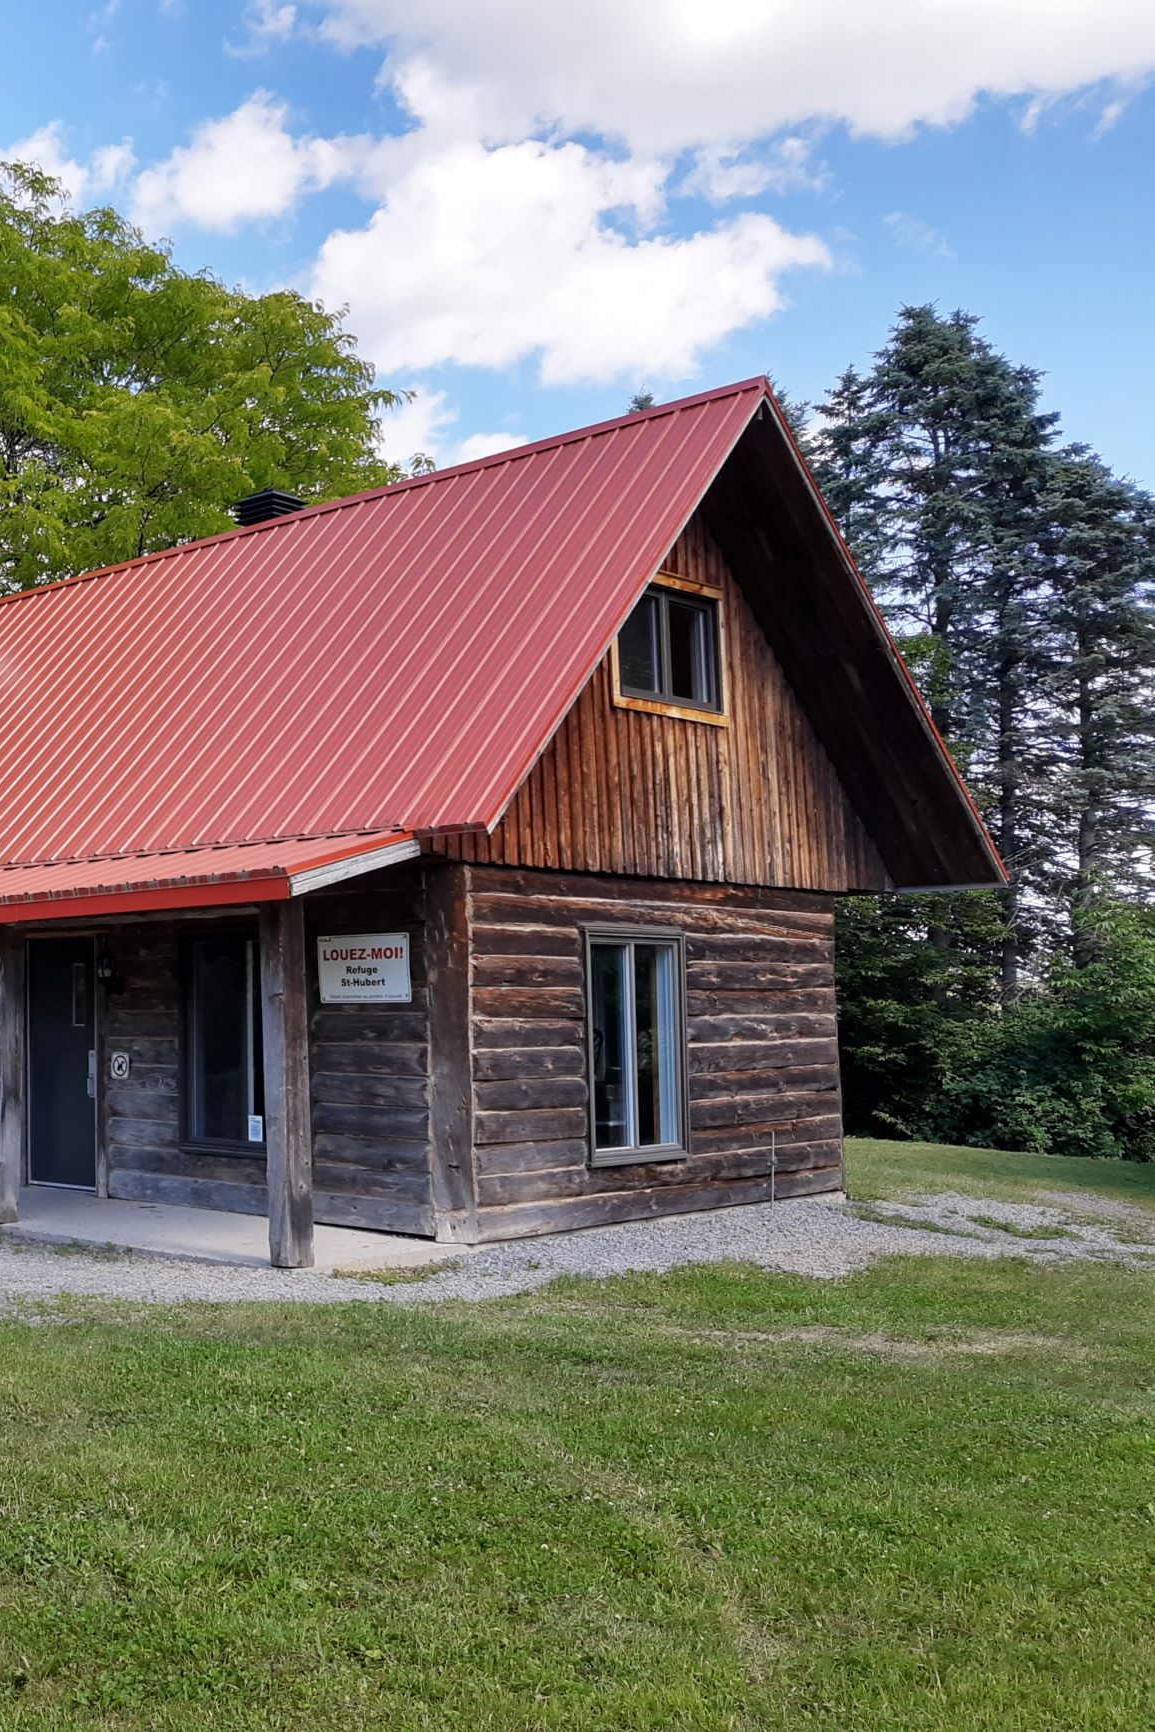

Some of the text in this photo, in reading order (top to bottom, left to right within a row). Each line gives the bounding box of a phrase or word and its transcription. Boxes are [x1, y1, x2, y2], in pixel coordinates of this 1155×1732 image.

[323, 947, 404, 961] LOUEZ-MOI!
[346, 966, 378, 976] Refuge
[341, 978, 386, 987] St-Hubert
